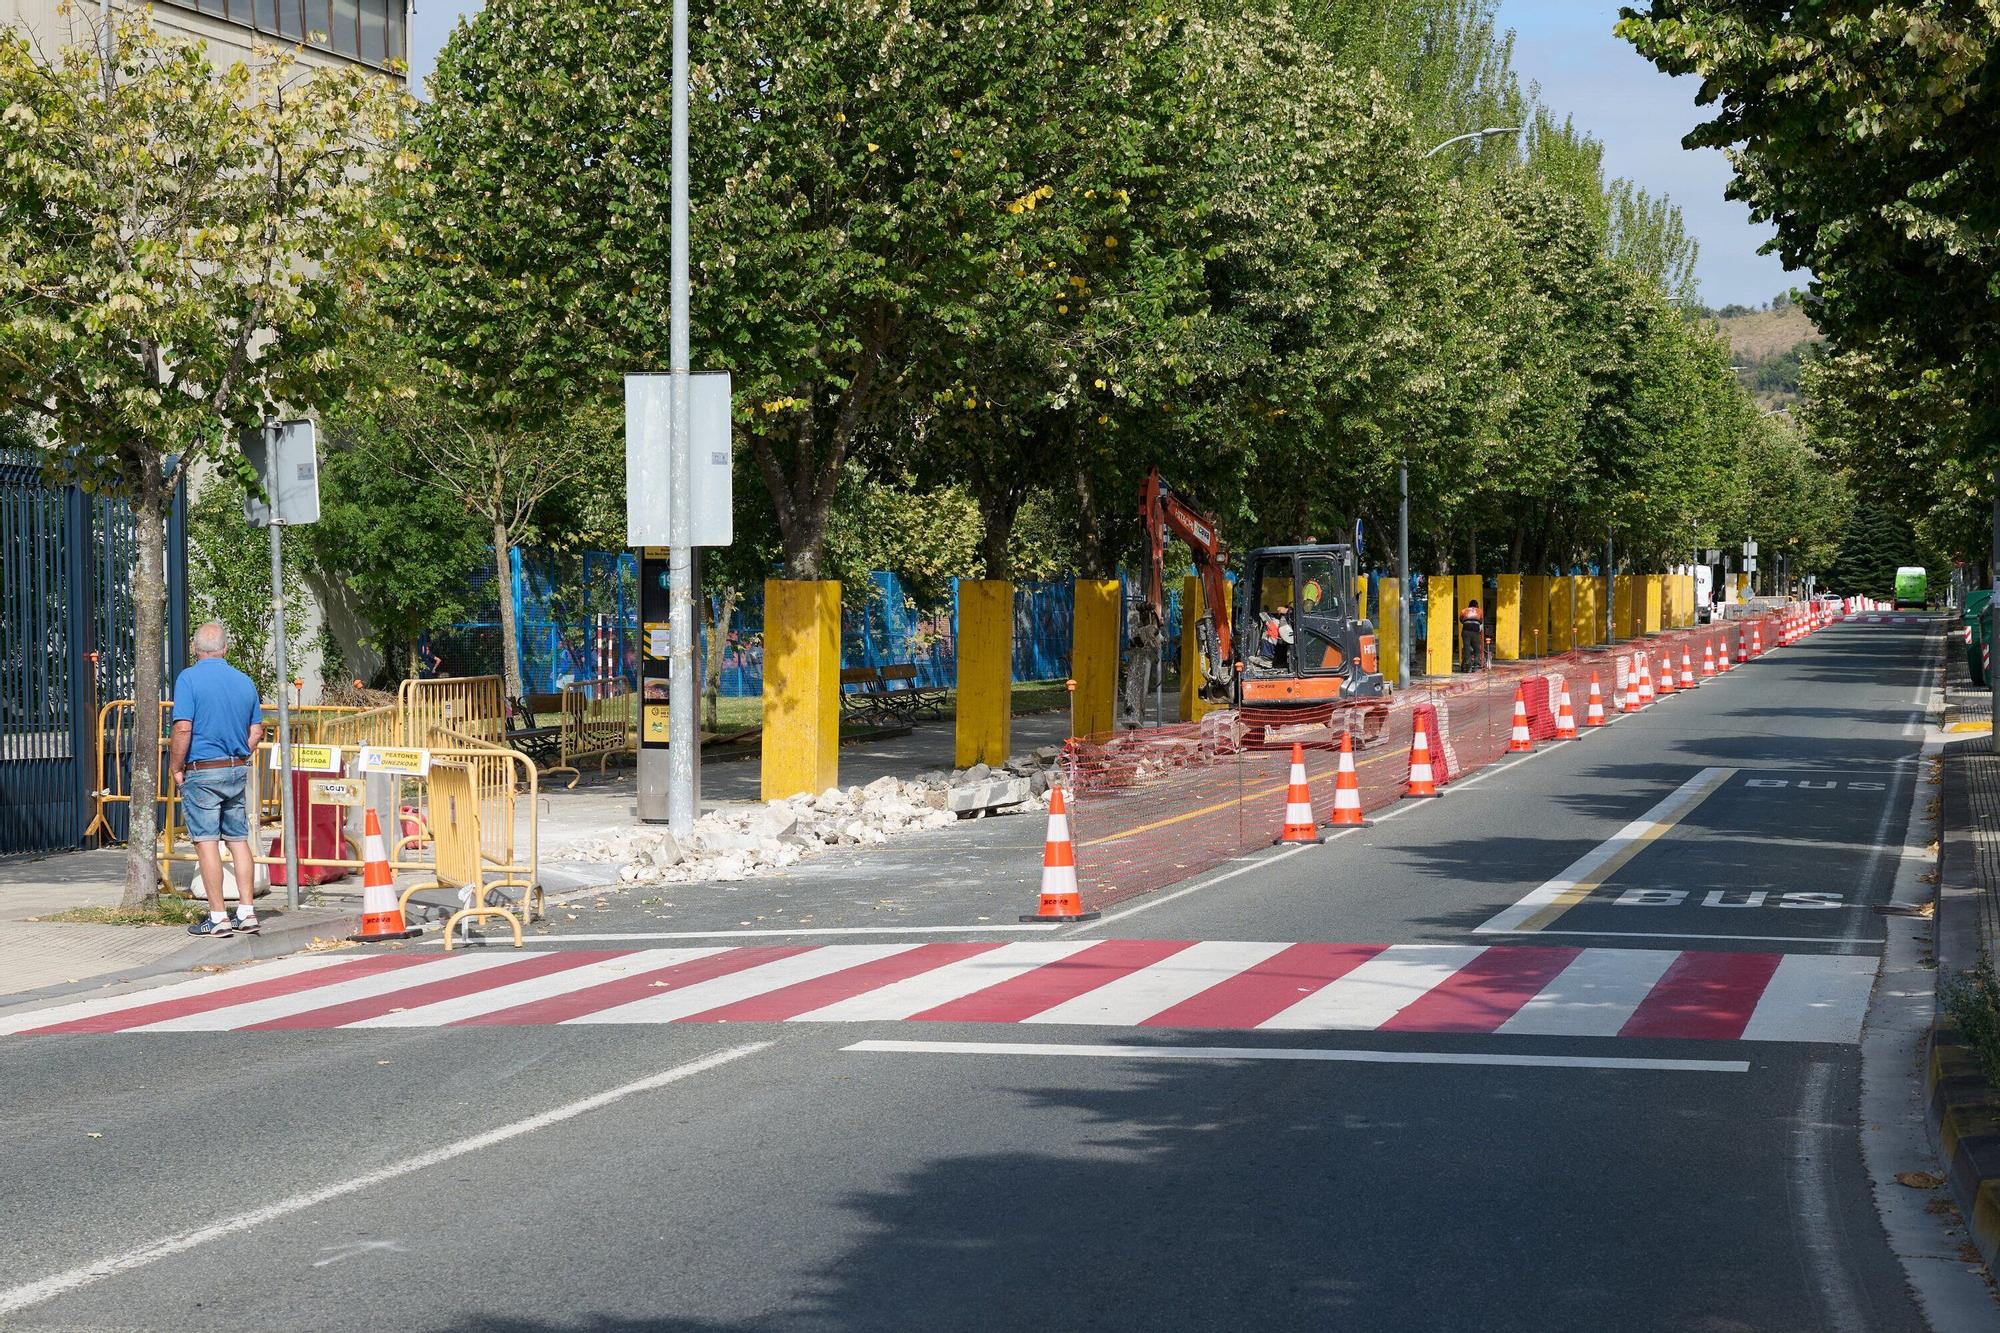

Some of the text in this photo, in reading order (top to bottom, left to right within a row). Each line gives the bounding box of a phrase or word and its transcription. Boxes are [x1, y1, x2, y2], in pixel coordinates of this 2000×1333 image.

[385, 752, 418, 760] PEATONES
[1744, 779, 1886, 791] BUS
[1612, 888, 1844, 910] BUS
